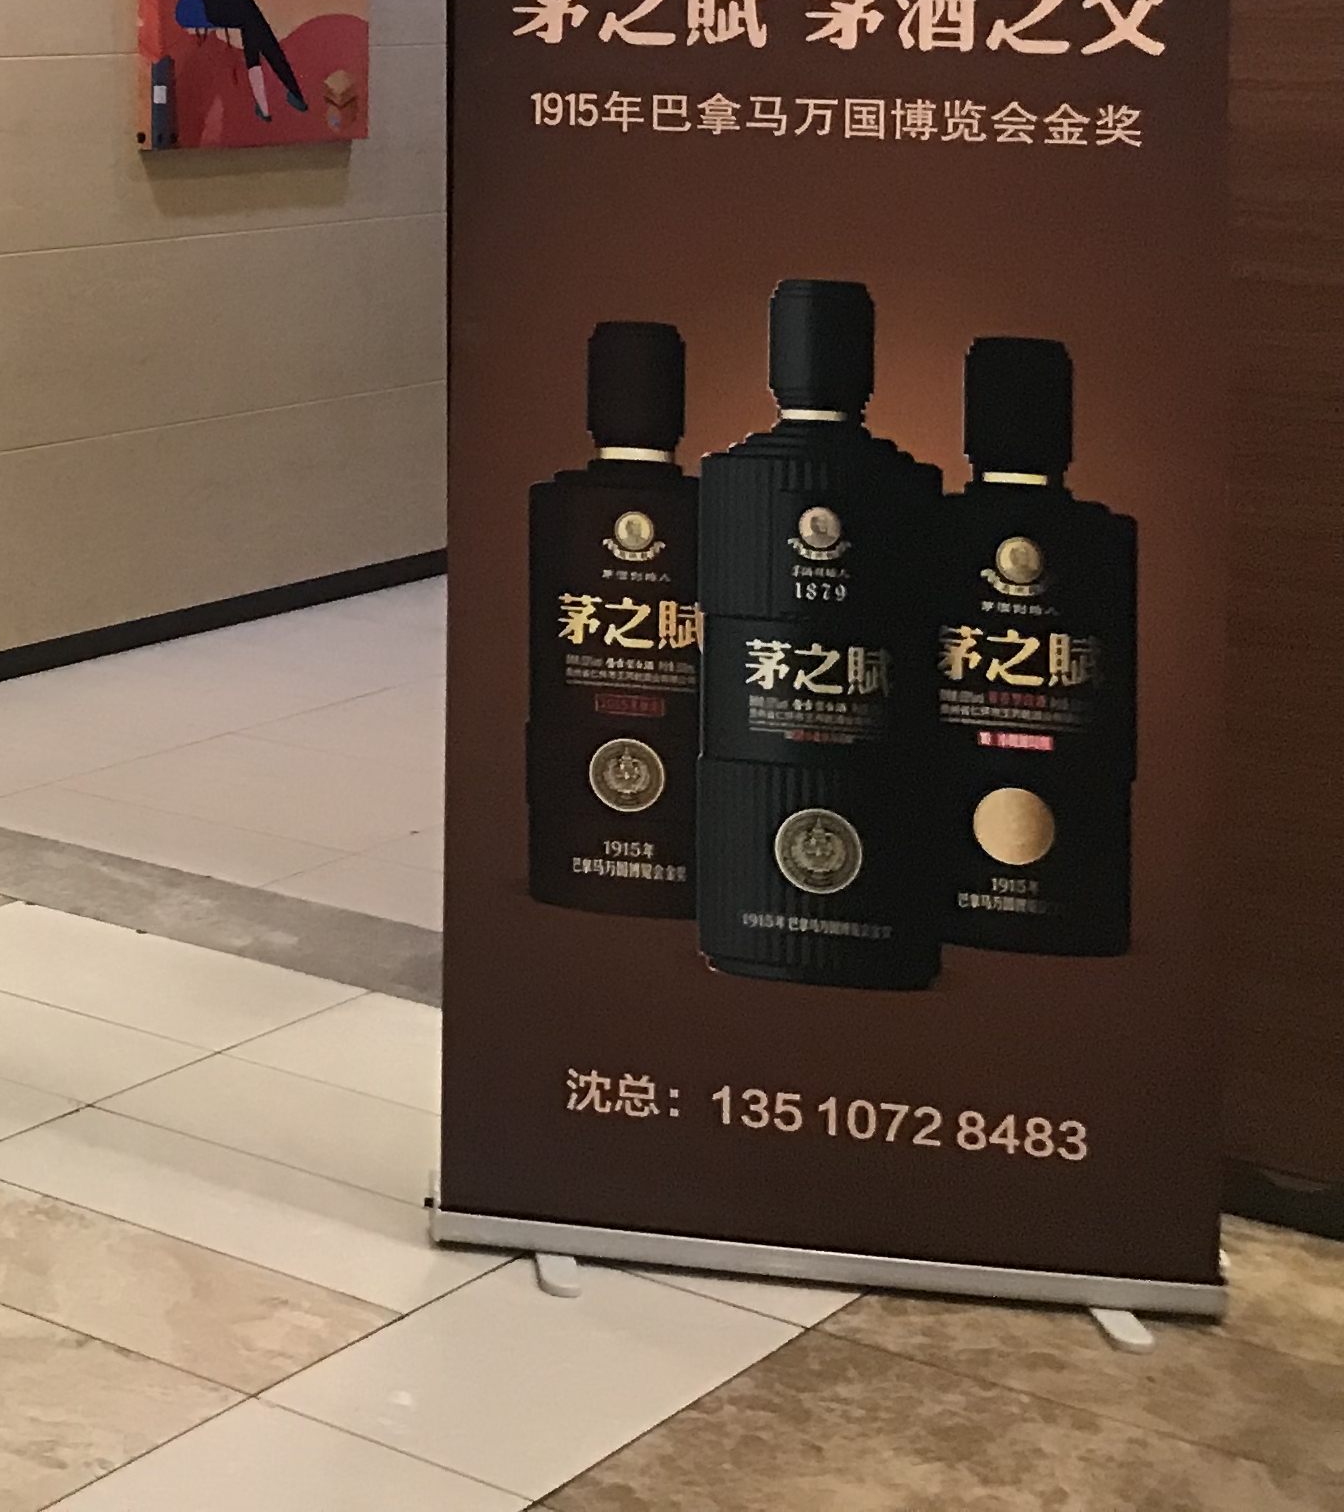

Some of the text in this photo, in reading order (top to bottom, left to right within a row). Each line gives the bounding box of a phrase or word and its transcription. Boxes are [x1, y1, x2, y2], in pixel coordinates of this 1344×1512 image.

[531, 91, 1144, 148] 1915年巴拿马万国博览会金奖
[793, 582, 848, 602] 1879
[602, 839, 656, 860] 1915年
